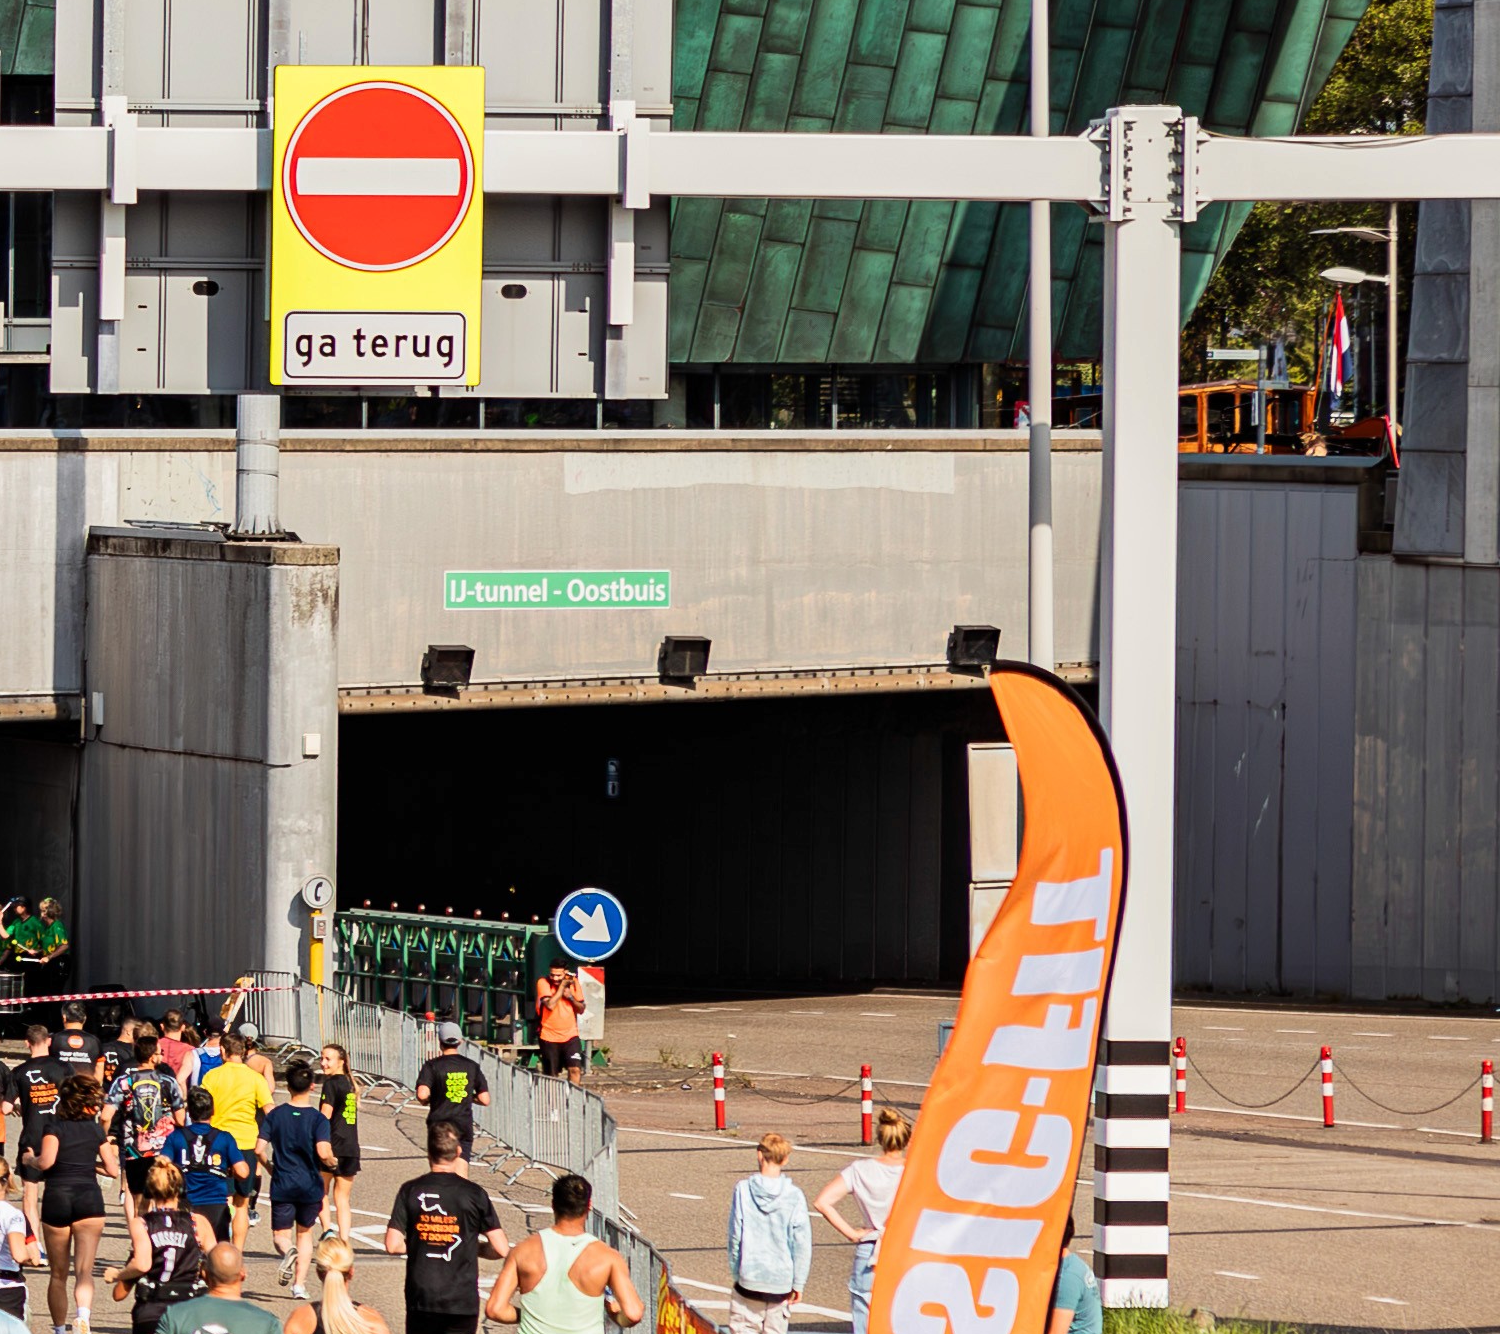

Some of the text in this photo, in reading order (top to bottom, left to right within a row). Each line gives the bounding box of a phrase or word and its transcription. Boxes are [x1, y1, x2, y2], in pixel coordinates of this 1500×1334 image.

[296, 328, 454, 367] ga terug
[450, 578, 548, 603] IJ-tunnel
[567, 577, 666, 602] Oostbuis
[160, 1248, 177, 1282] 1
